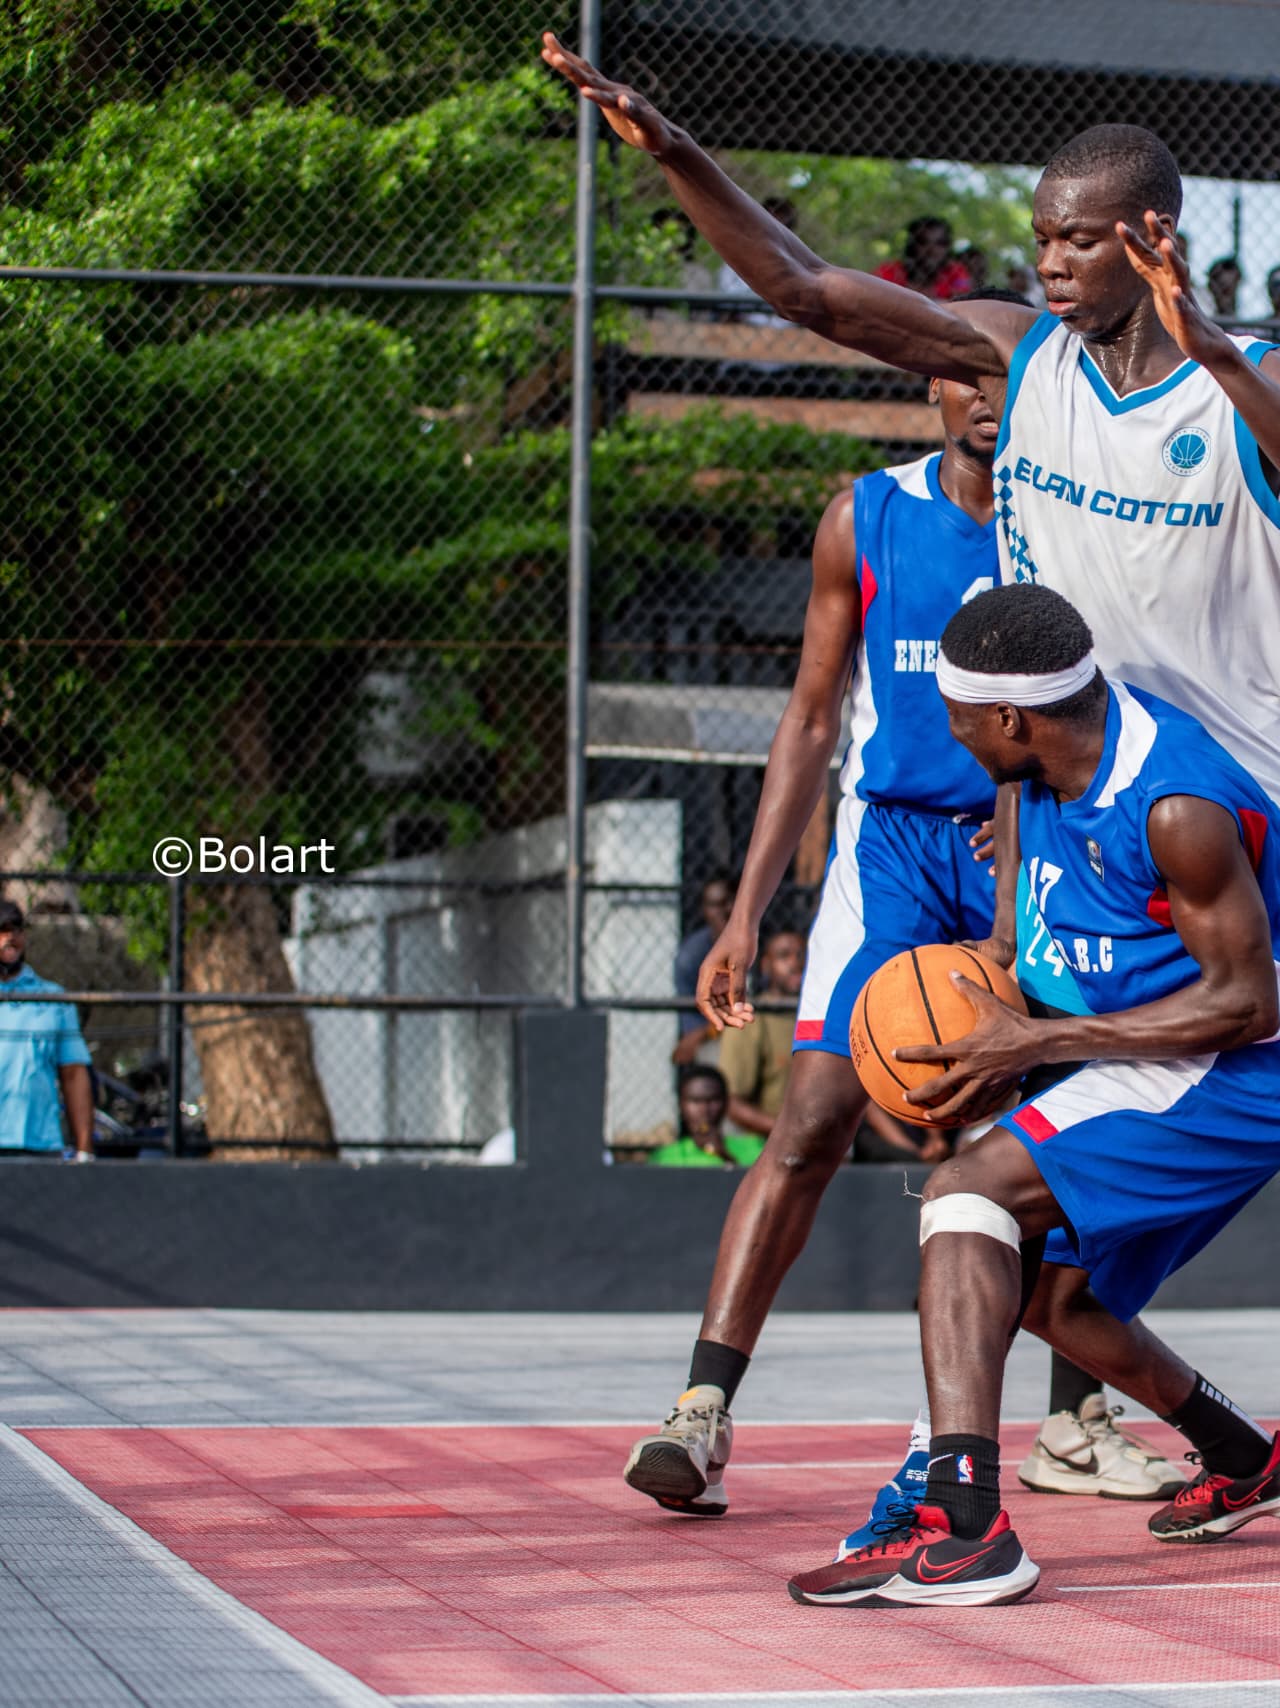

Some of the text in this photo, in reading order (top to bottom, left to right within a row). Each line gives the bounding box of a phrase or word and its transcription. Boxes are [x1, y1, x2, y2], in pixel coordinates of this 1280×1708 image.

[1014, 456, 1225, 528] ELAN COTON
[894, 639, 941, 673] ENE
